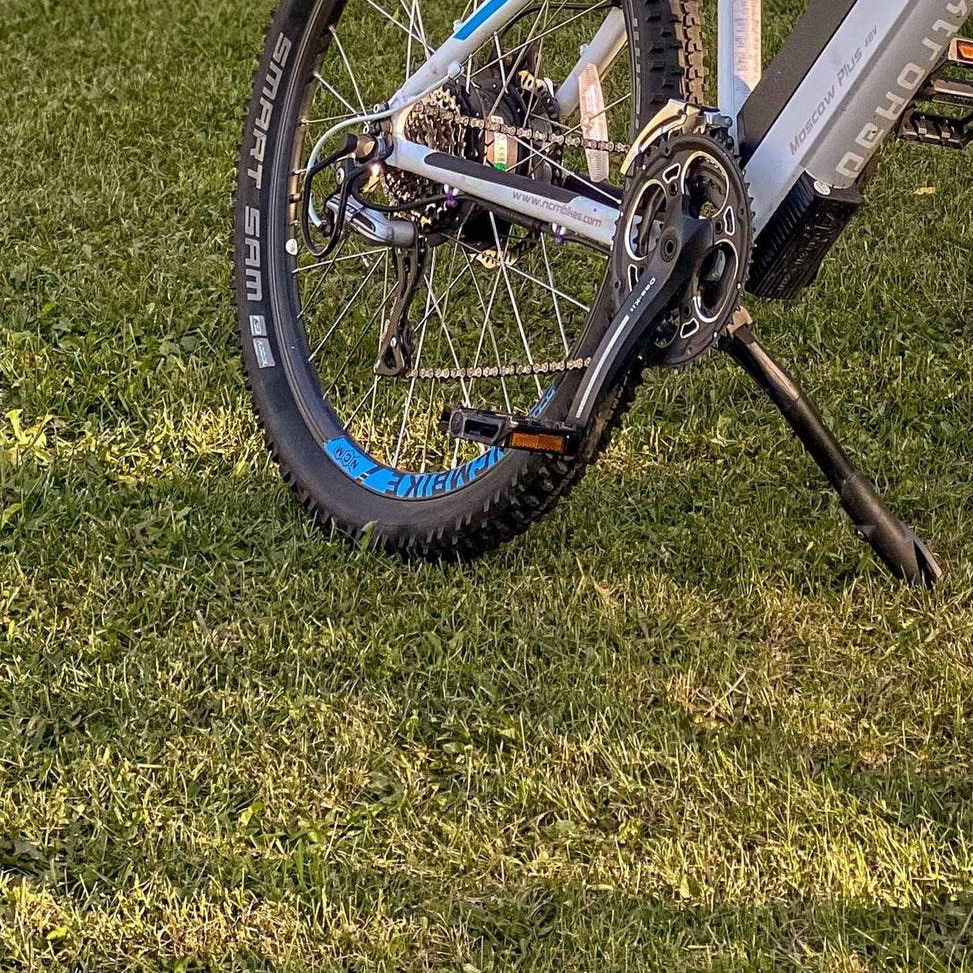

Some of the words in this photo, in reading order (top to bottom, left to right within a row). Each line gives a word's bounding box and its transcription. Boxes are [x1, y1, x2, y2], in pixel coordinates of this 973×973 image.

[836, 47, 863, 86] Plus
[248, 32, 292, 190] SMART
[512, 190, 602, 227] www.ncmbikes.com
[244, 206, 262, 301] SAM
[334, 446, 358, 470] NCM
